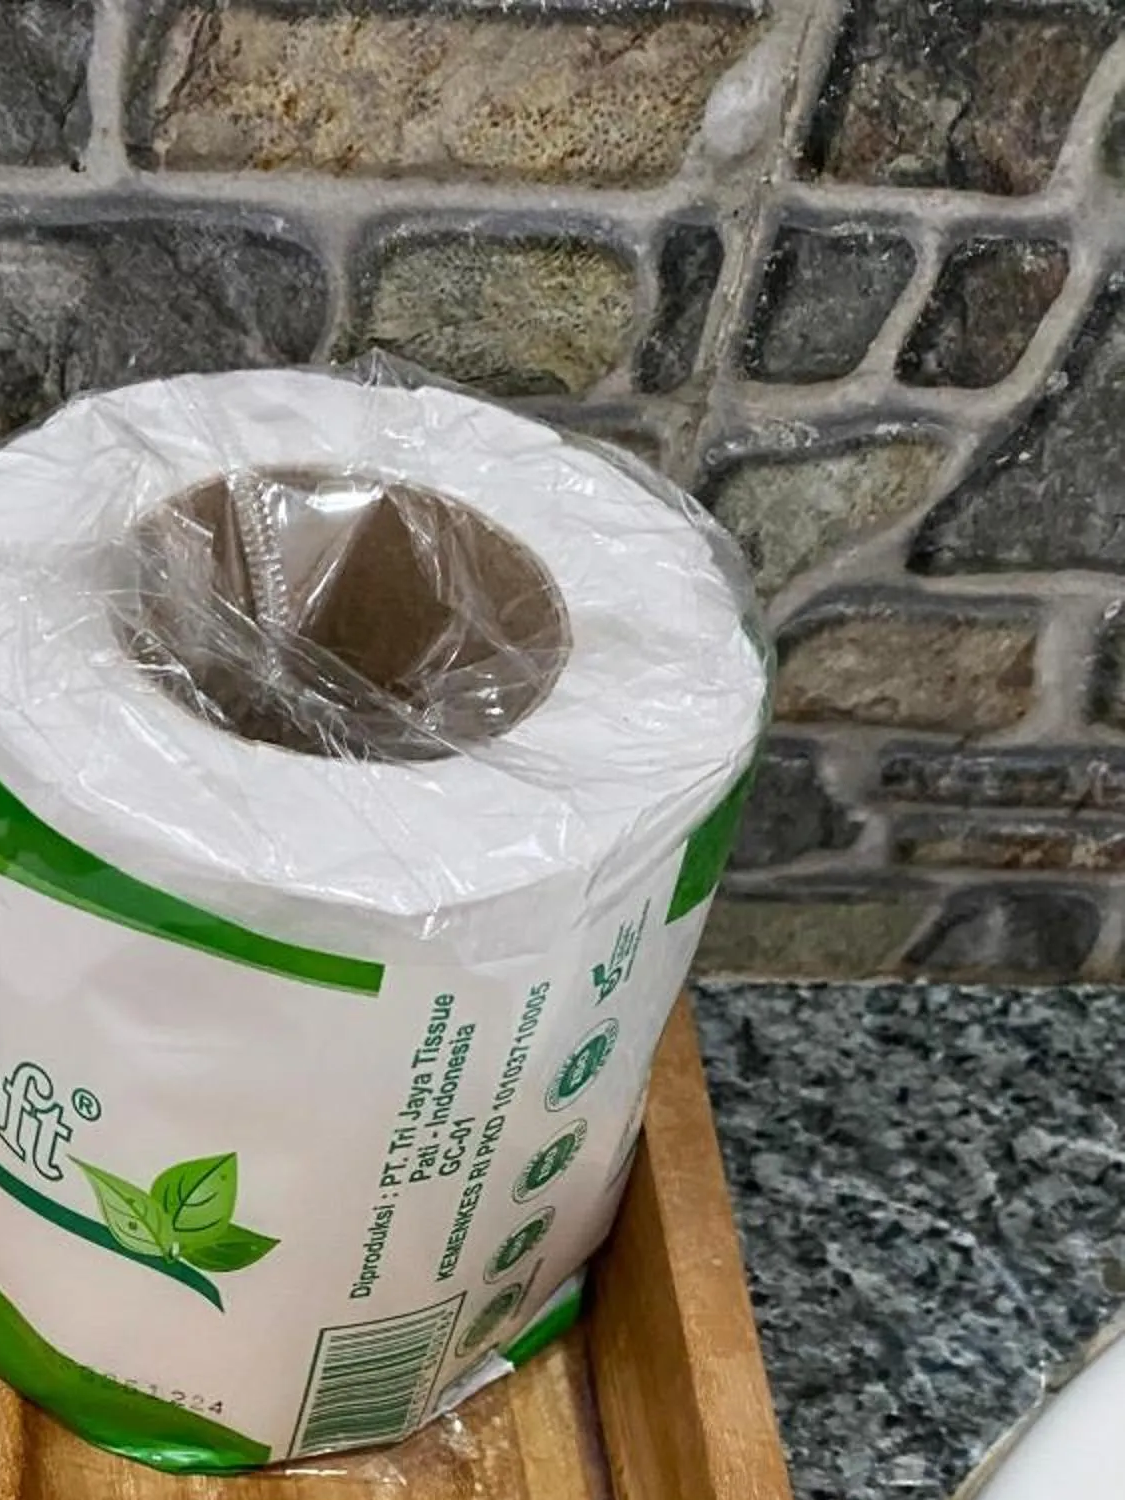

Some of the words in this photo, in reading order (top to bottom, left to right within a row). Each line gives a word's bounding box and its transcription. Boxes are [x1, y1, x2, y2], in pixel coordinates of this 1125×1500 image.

[411, 992, 456, 1070] Tissue
[492, 980, 551, 1112] 10103710005
[398, 1072, 432, 1121] Jaya
[408, 1149, 438, 1185] Pati
[425, 1022, 477, 1130] Indonesia
[389, 1125, 416, 1156] Tri
[438, 1116, 476, 1177] GC-01
[476, 1114, 507, 1161] PKD
[380, 1157, 409, 1189] PT.
[468, 1157, 492, 1186] RI
[349, 1202, 396, 1299] Diproduksi
[435, 1183, 484, 1282] KEMENKES
